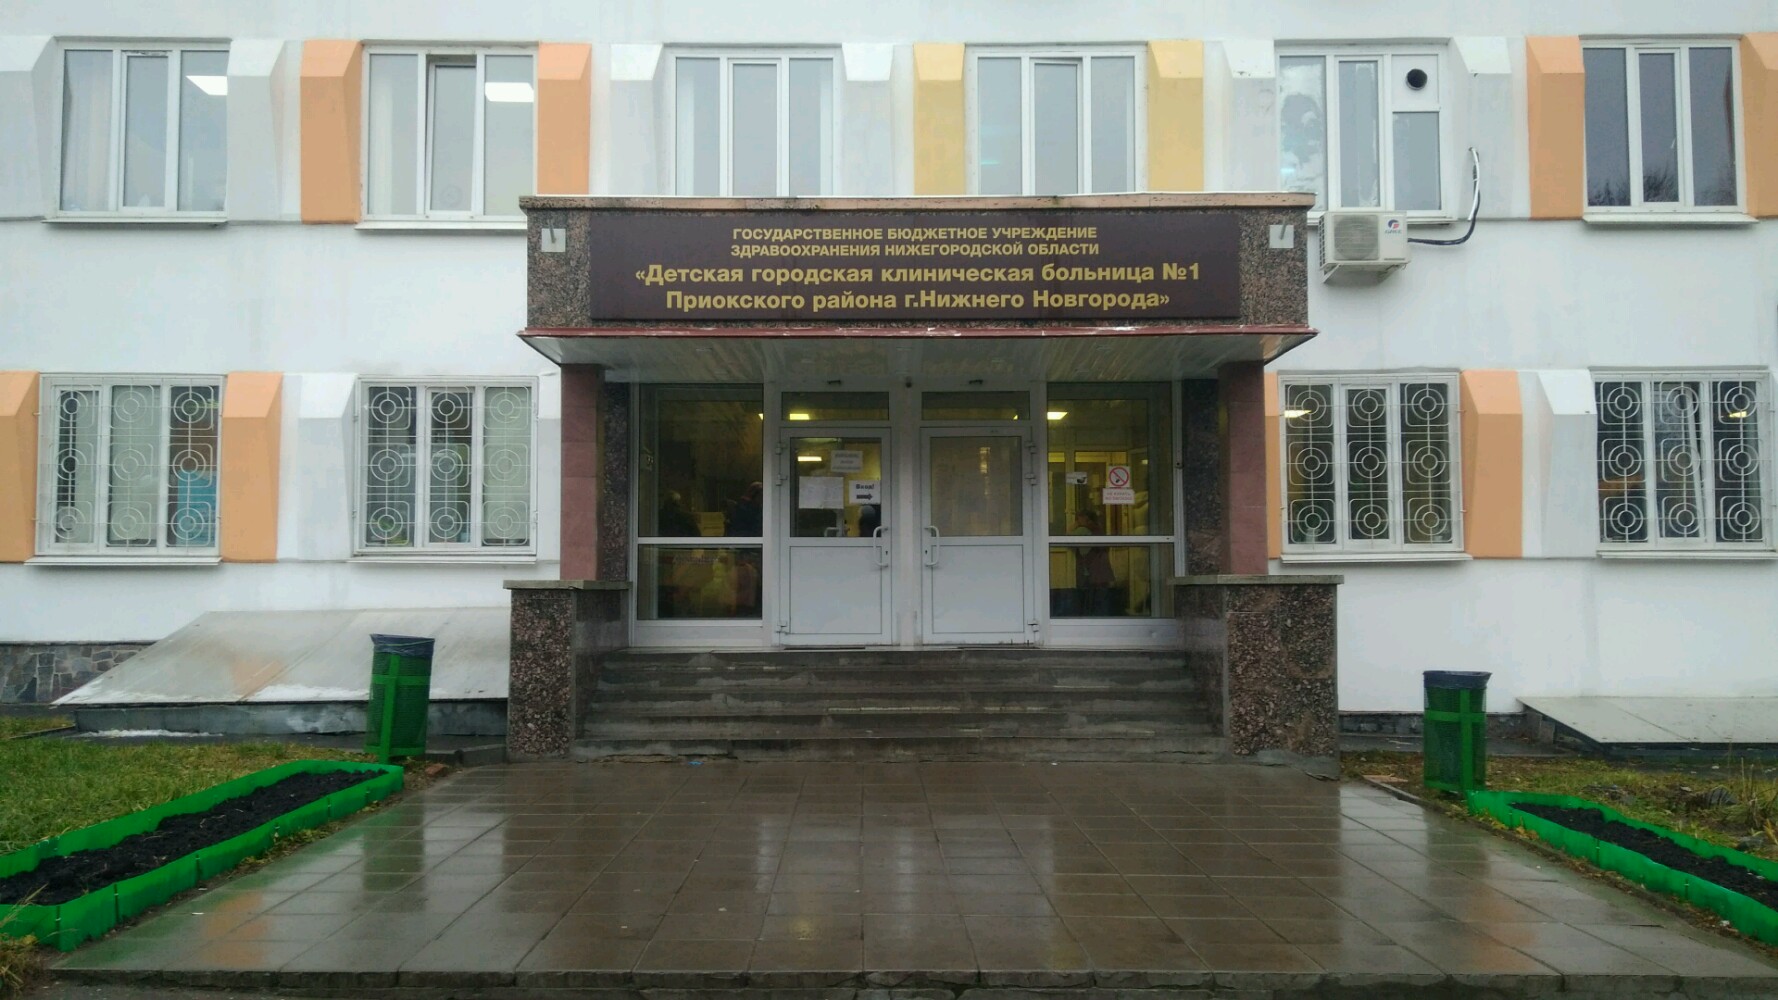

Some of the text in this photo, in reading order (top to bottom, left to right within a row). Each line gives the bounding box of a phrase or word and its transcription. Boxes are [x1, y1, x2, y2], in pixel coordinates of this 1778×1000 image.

[732, 227, 1098, 242] ГОСУДАРСТВЕННОЕ БЮДЖЕТНОЕ УЧРЕЖДЕНИЕ
[731, 241, 1100, 258] ЗДРАВООХРАНЕНИЯ НИЖЕГОРОДСКОЙ ОБЛАСТИ
[635, 262, 1200, 286] «Детская городская клиническая больница №1
[666, 289, 1170, 313] Приокского района г.Нижнего Новгорода»
